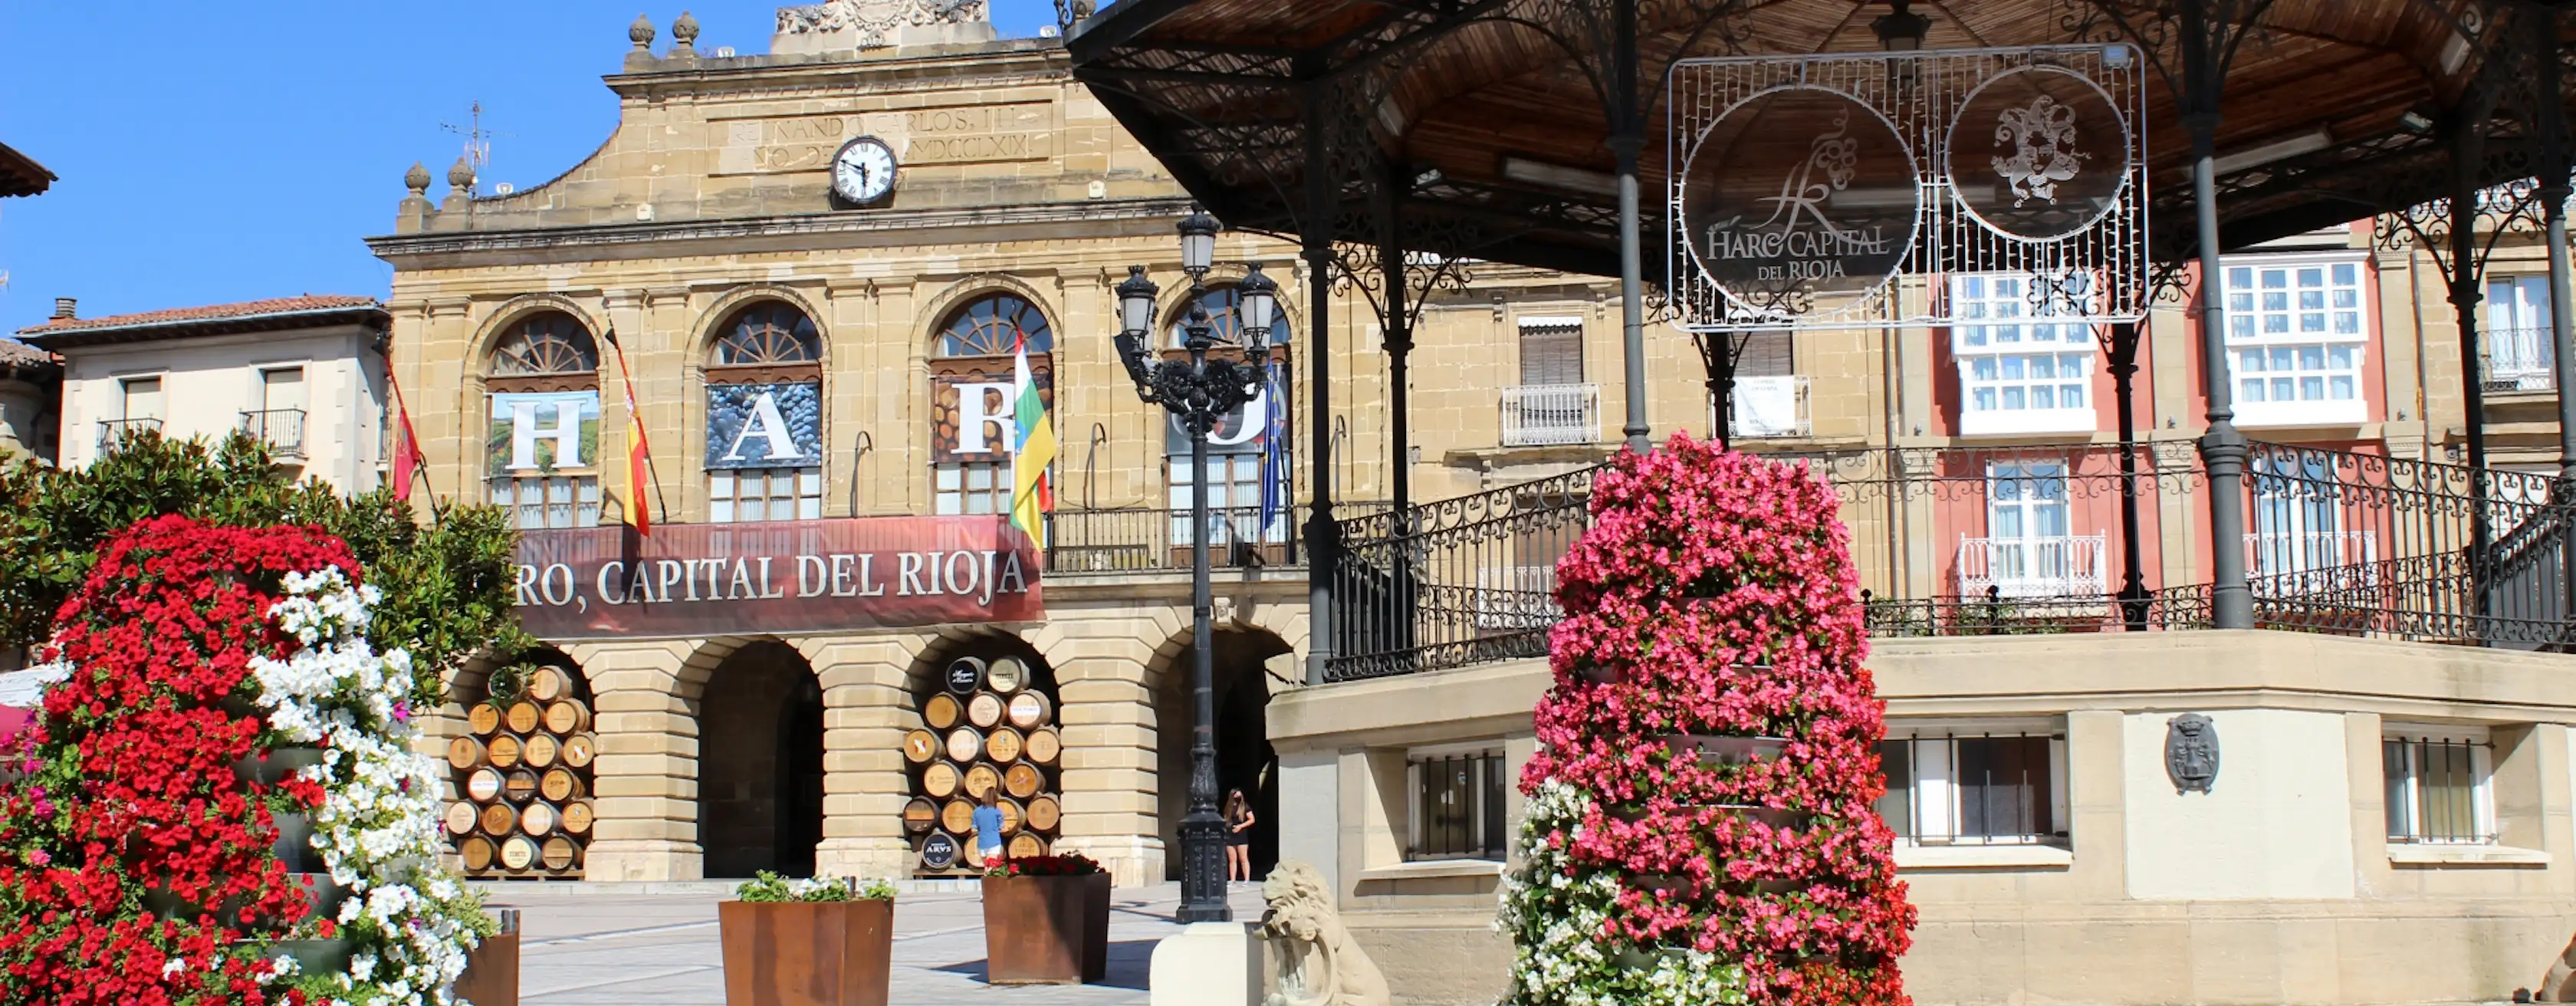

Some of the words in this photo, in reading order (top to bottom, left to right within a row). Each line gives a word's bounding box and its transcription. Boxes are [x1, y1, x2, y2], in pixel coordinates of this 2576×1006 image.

[1707, 231, 1784, 261] HARO
[1787, 226, 1891, 258] CAPITAL
[1758, 265, 1784, 281] DEL
[1789, 259, 1847, 284] RIOJA
[504, 399, 589, 470] H
[721, 391, 804, 461] A
[951, 383, 1015, 454] R
[512, 562, 587, 613] RO,
[597, 556, 784, 605] CAPITAL
[796, 553, 884, 598] DEL
[895, 549, 1027, 607] RIOJA
